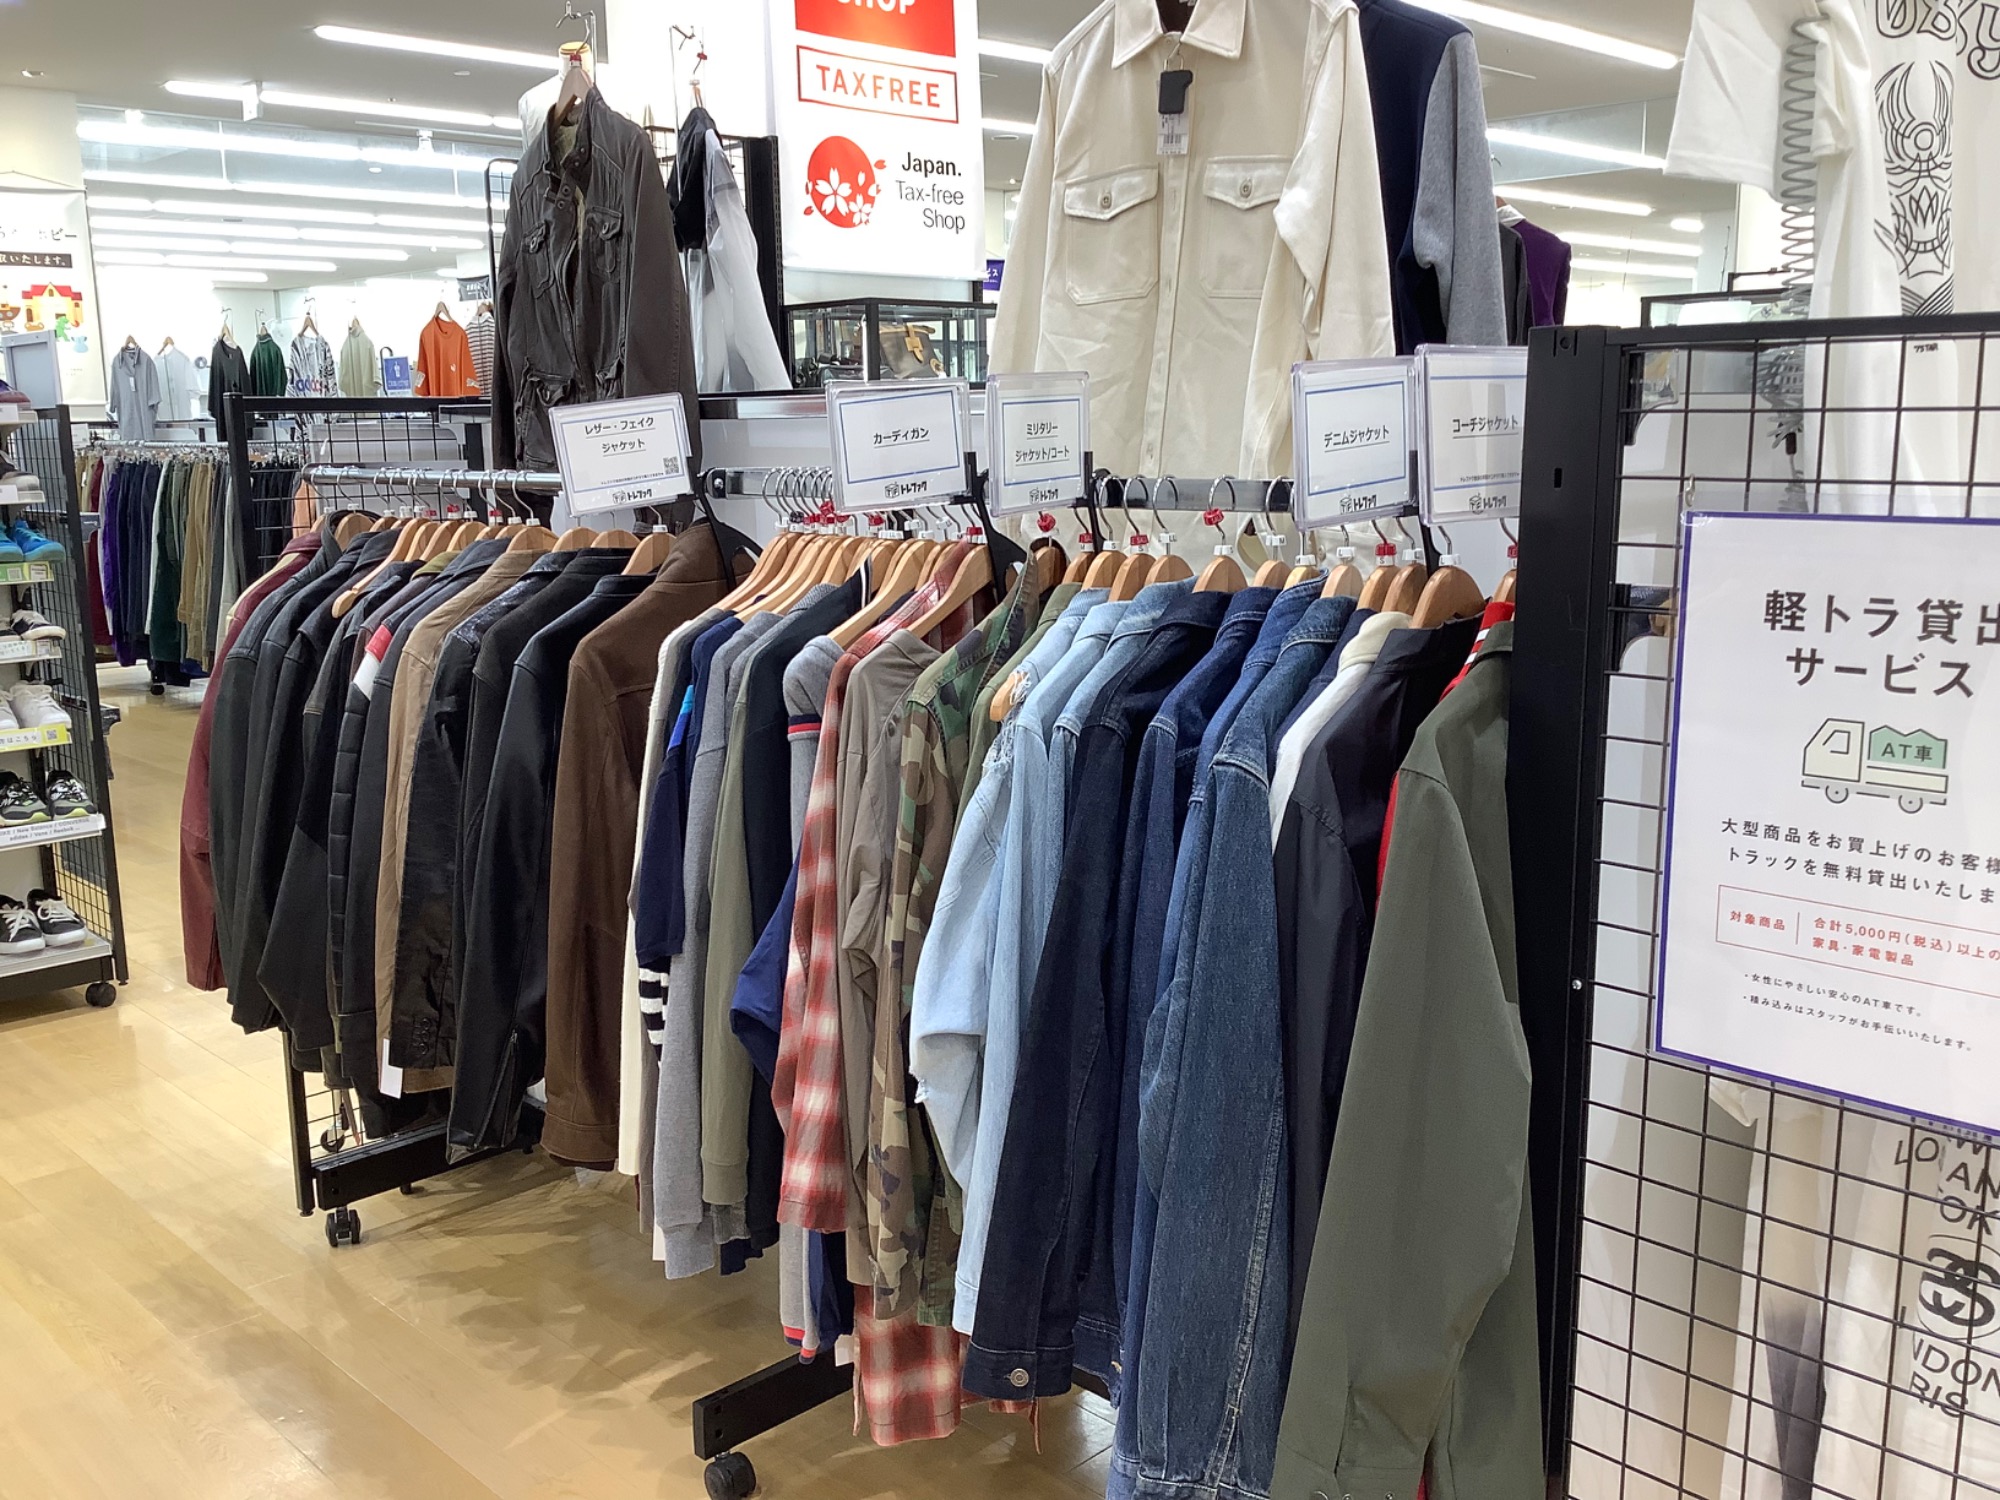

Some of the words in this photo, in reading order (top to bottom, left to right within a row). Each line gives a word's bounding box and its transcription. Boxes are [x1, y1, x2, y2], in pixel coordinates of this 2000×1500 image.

[816, 64, 940, 108] TAXFREE
[902, 152, 962, 178] Japan.
[895, 180, 964, 206] Tax-free
[923, 208, 965, 234] Shop
[585, 417, 654, 435] レザー・フェイク
[1026, 422, 1058, 436] ミリタリー
[1452, 415, 1518, 433] コーチジャケット
[602, 438, 645, 453] ジャケット
[873, 427, 929, 445] カーディガン
[1324, 424, 1390, 448] デニムジャケット
[1015, 445, 1070, 462] ジャケット/コート
[1786, 647, 1973, 698] サービス
[1881, 742, 1933, 762] AT車
[1728, 847, 1995, 903] トラックを無料貸出いたしま
[1730, 910, 1785, 931] 対象商品
[1813, 937, 1914, 966] 家具・家電製品
